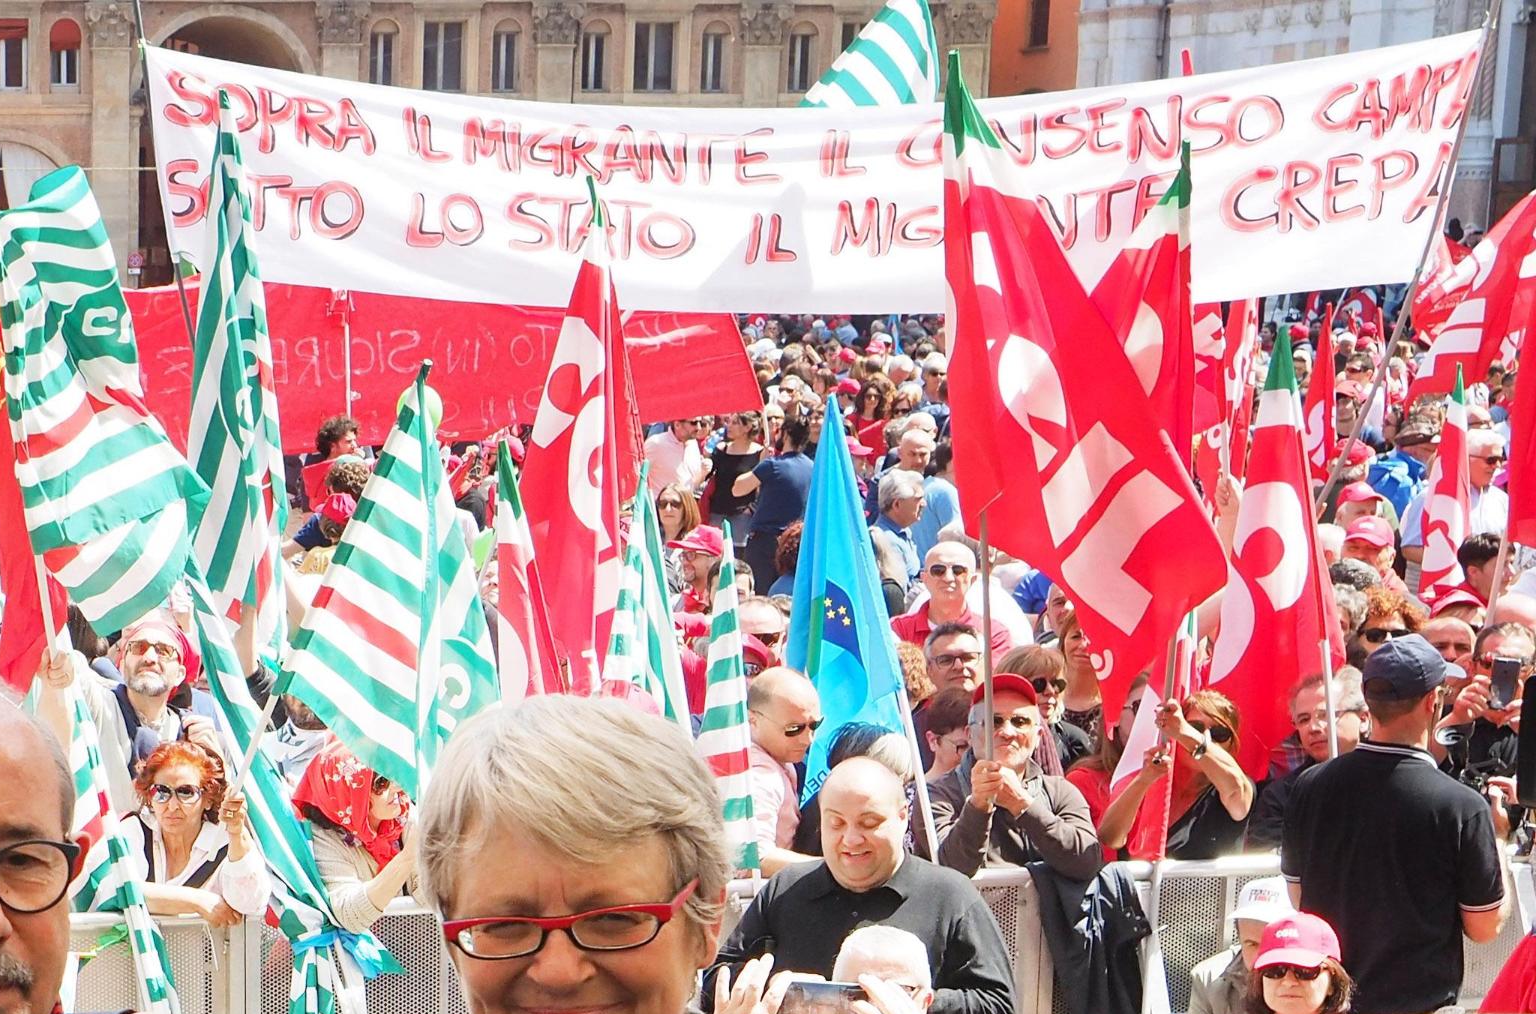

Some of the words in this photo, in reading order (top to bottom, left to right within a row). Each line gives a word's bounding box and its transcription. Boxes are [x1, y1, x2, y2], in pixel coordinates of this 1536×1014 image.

[163, 69, 376, 156] SOPRA
[403, 106, 454, 162] IL
[463, 115, 783, 186] MIGRANTE
[819, 129, 867, 179] IL
[896, 94, 1284, 168] CNSENSO
[166, 159, 364, 240] STTO
[406, 192, 484, 247] LO
[505, 192, 696, 260] STATO
[745, 213, 797, 265] IL
[831, 169, 1181, 257] MIGNTE
